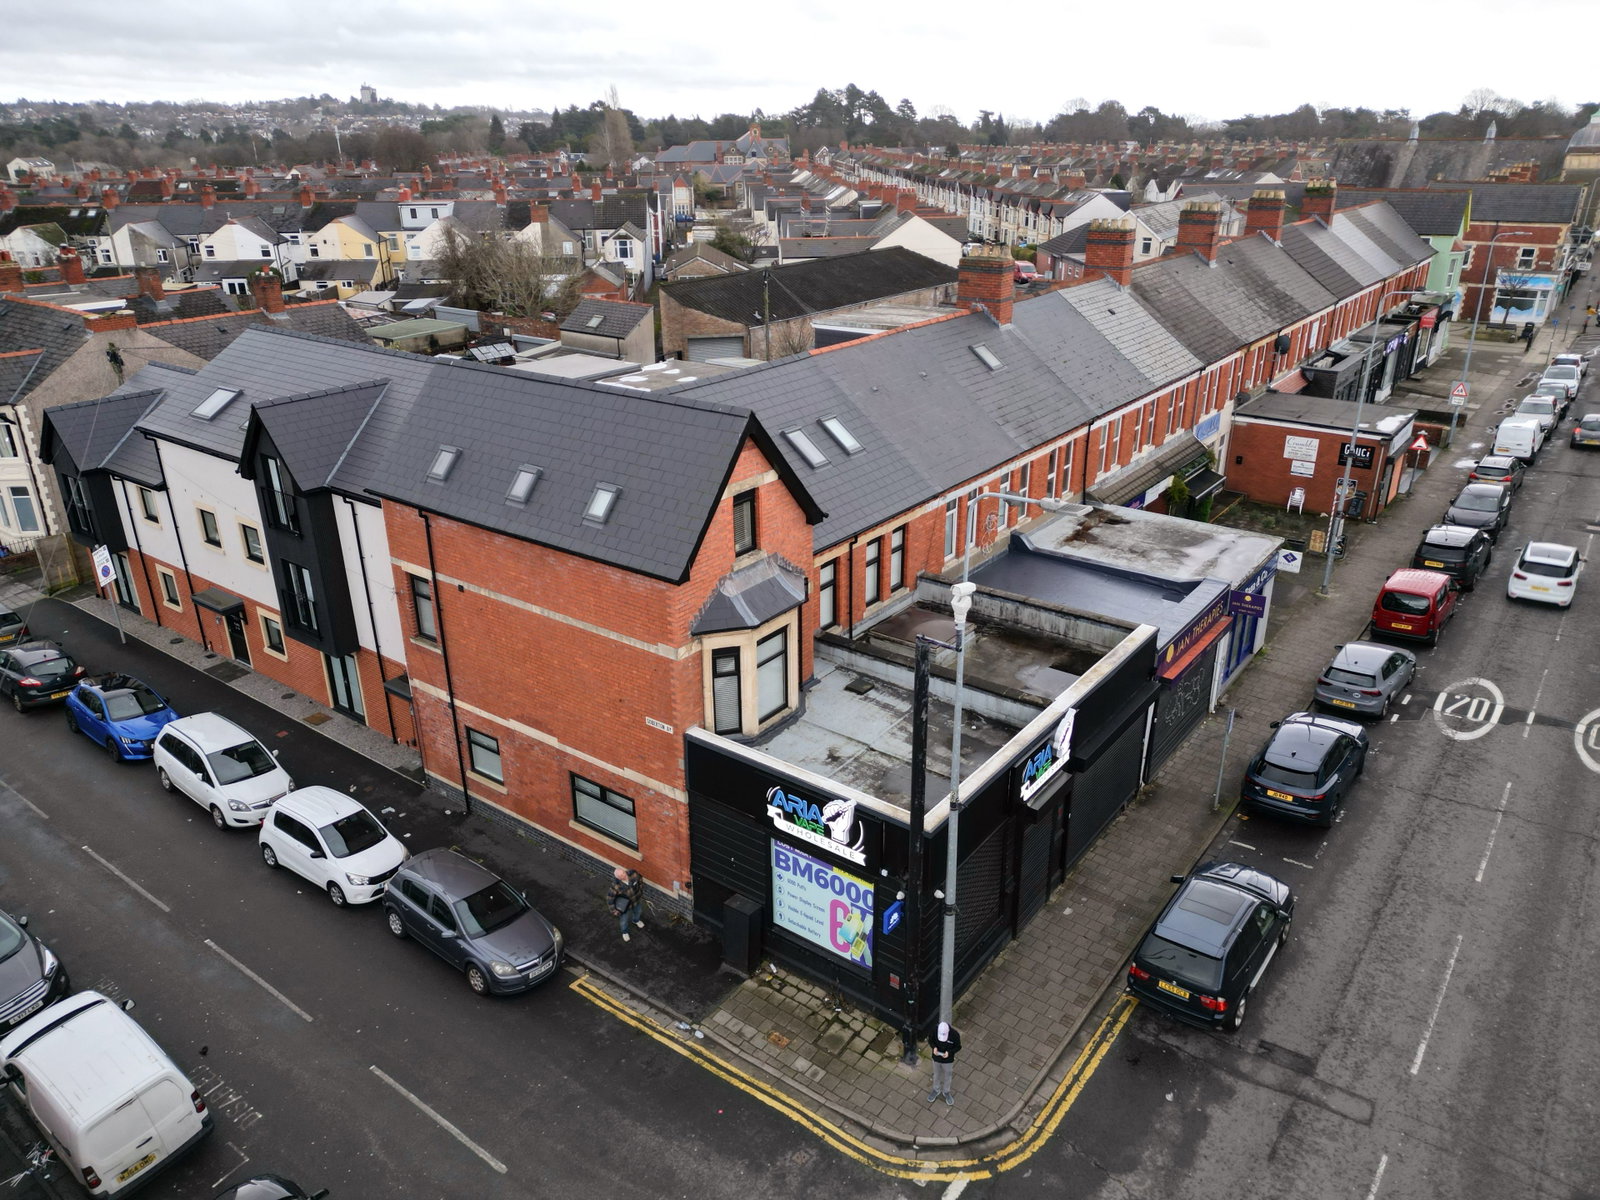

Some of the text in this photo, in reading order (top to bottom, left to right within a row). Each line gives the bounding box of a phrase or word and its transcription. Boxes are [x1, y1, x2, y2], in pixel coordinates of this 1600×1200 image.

[1175, 600, 1225, 656] JAN THERAPIES
[1443, 693, 1491, 721] 20
[1024, 744, 1053, 784] ARIA
[772, 789, 824, 827] ARIA
[786, 823, 855, 860] WHOLESALE
[793, 814, 825, 837] VAPE
[812, 901, 825, 913] Screen
[807, 924, 821, 939] Battery
